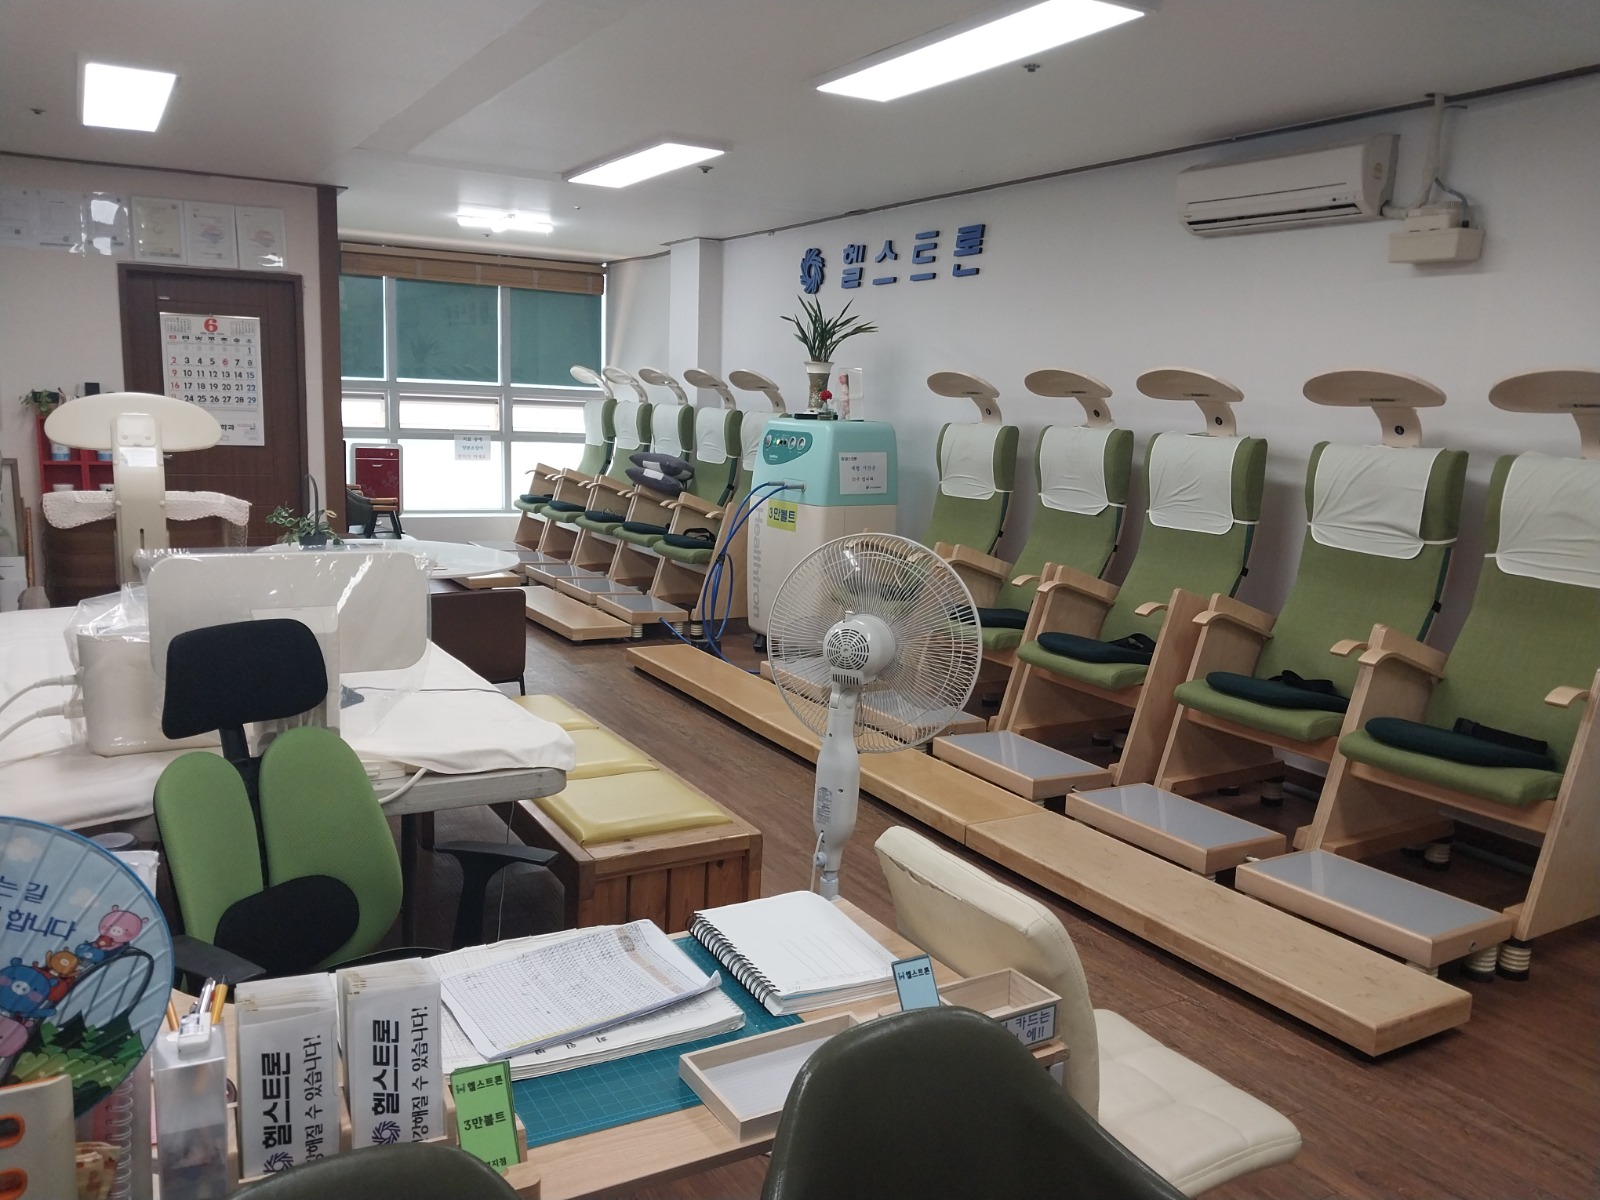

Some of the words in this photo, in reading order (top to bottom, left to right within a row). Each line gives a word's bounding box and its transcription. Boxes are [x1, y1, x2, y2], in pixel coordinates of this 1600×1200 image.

[841, 223, 986, 289] 헬스트론
[204, 318, 218, 333] 6
[184, 357, 190, 365] 3
[197, 357, 203, 365] 4
[222, 358, 228, 366] 6
[172, 369, 177, 377] 9
[183, 369, 193, 377] 10
[208, 370, 218, 378] 12
[246, 384, 256, 392] 22
[197, 395, 207, 403] 25
[246, 396, 257, 404] 29
[769, 507, 796, 524] 3만볼트
[753, 507, 764, 619] Healthtron
[24, 882, 48, 904] 길
[6, 909, 76, 941] 합니다
[906, 967, 930, 980] 헬스트론
[1016, 1012, 1050, 1030] 카드는
[411, 1006, 429, 1072] 있습니다!
[303, 1035, 322, 1101] 있습니다!
[371, 1019, 400, 1116] 헬스트론
[412, 1076, 429, 1090] 수
[467, 1075, 503, 1092] 헬스트론
[261, 1052, 292, 1149] 헬스트론
[305, 1104, 323, 1120] 수
[464, 1111, 506, 1131] 3만볼트
